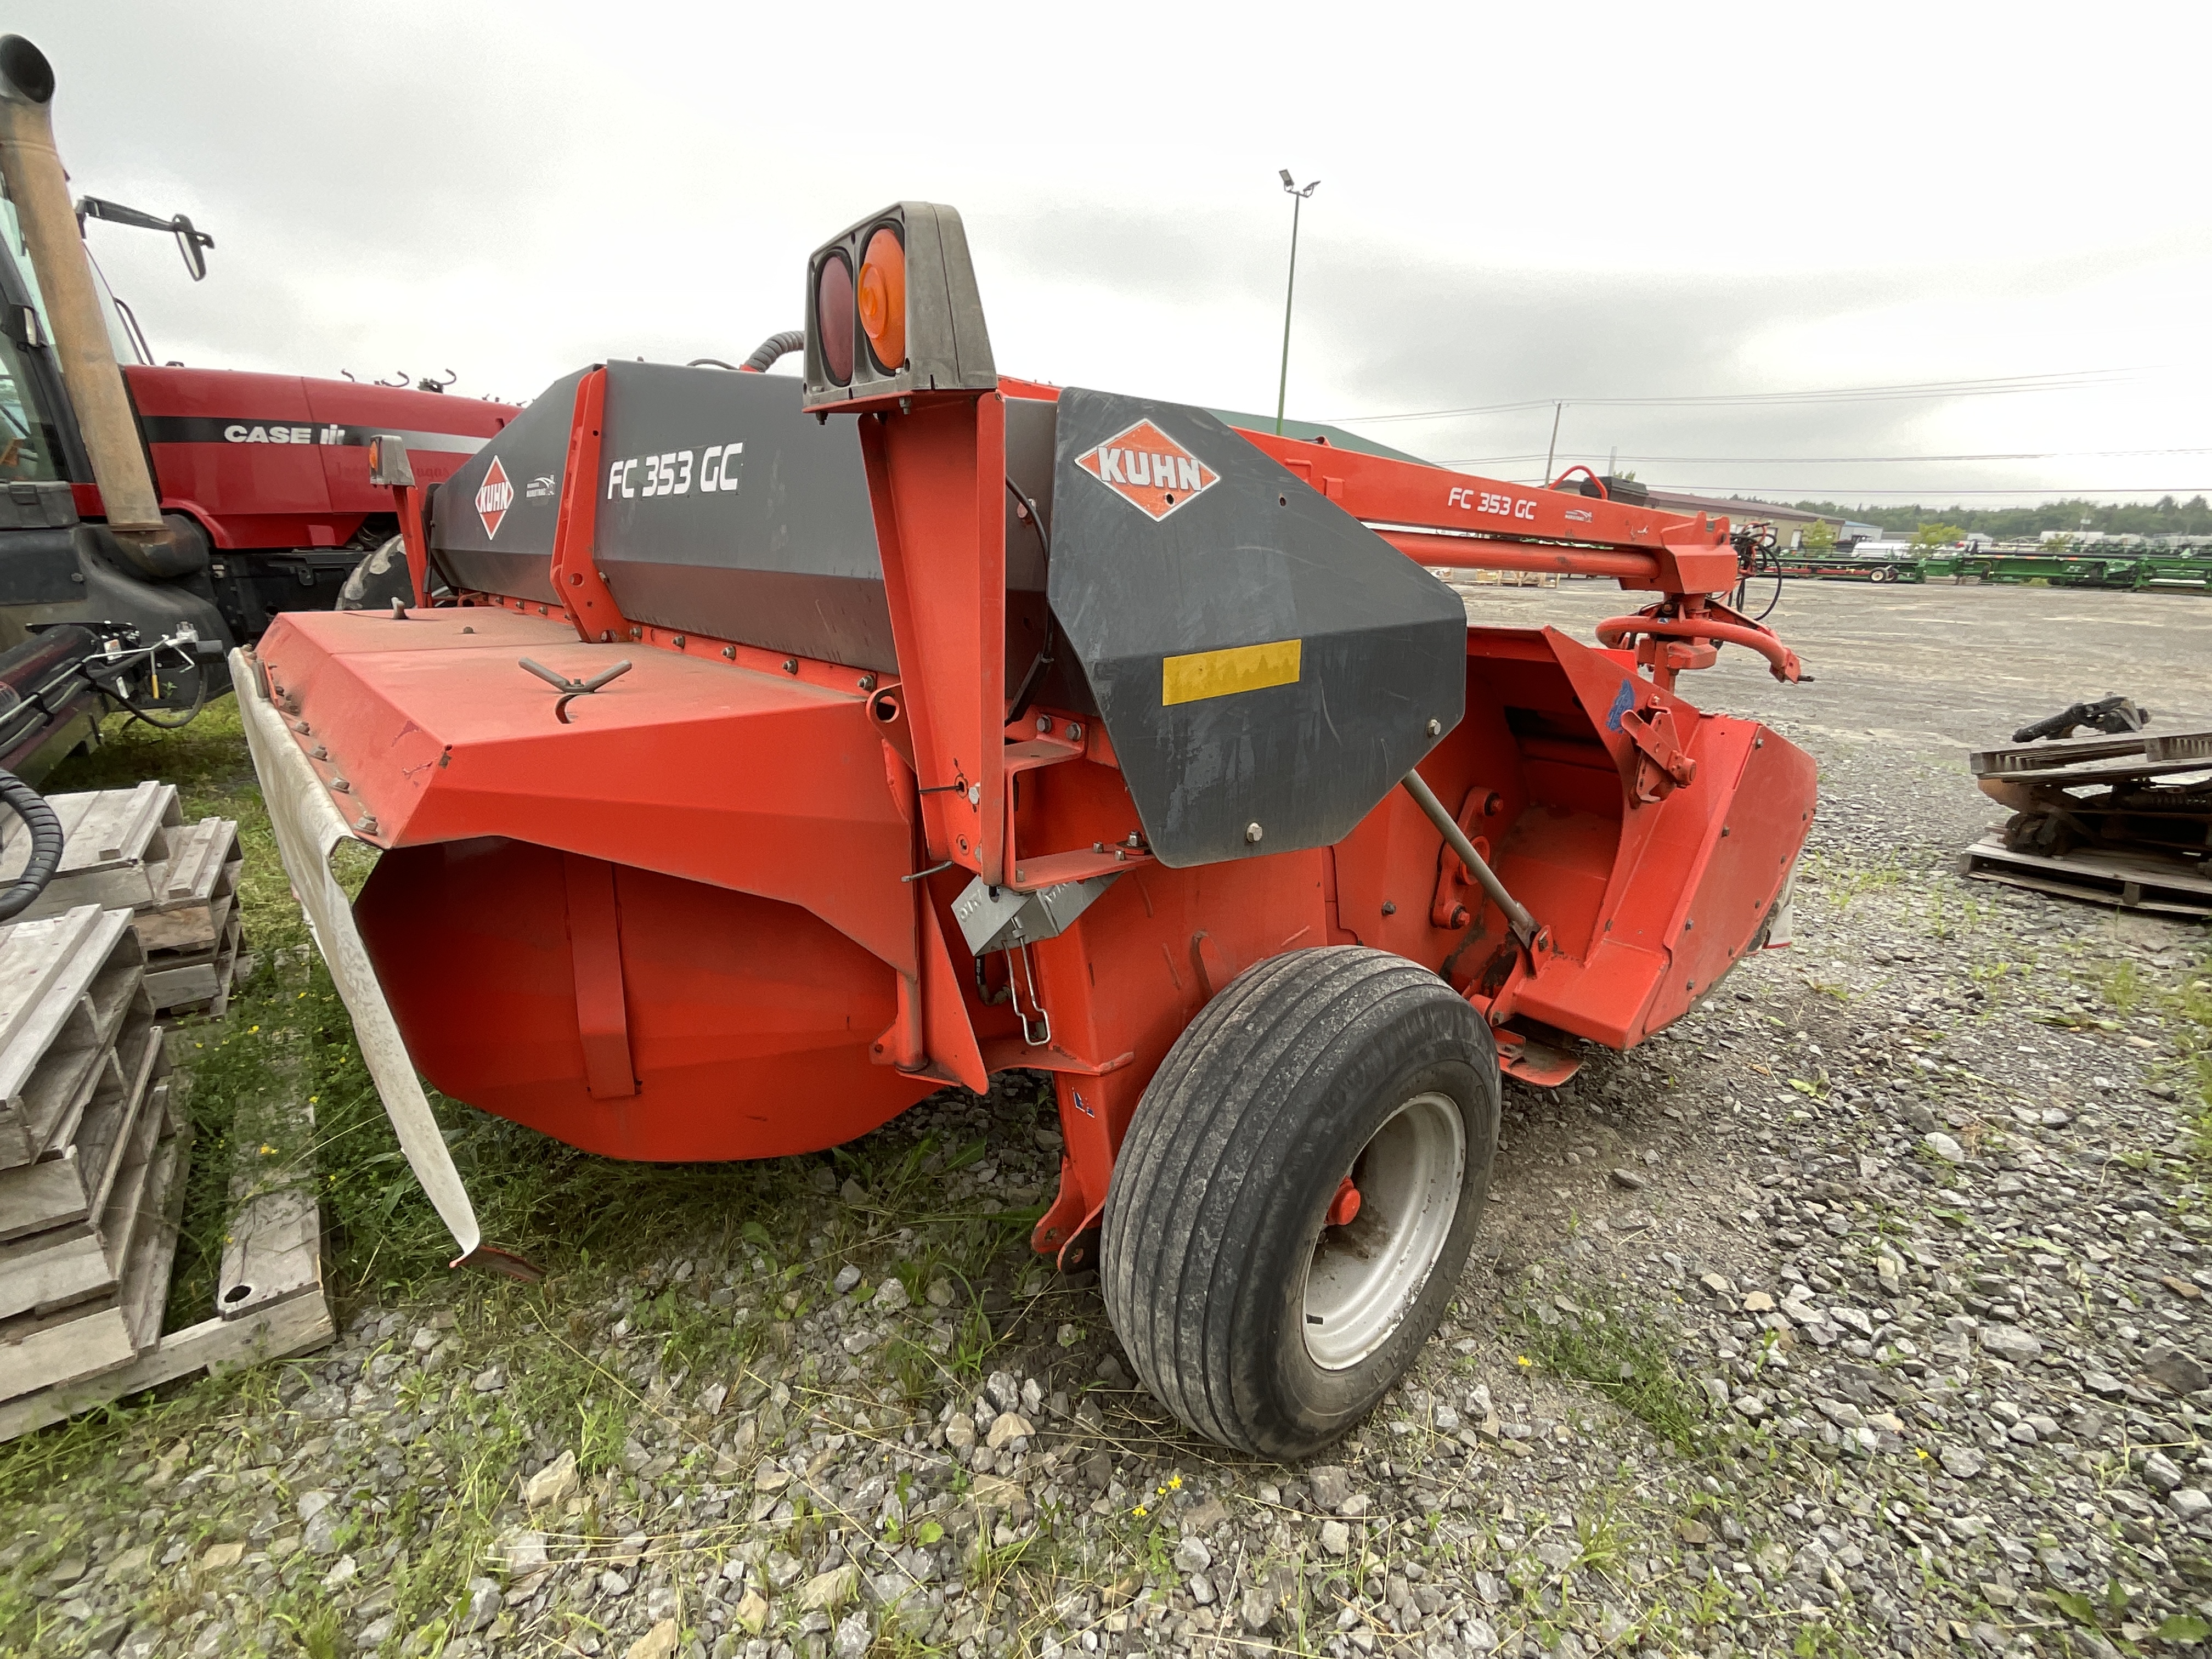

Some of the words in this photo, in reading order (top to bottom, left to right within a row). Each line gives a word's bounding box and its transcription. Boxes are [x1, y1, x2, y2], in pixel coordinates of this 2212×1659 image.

[224, 425, 312, 444] CASE
[607, 459, 637, 499] FC
[642, 450, 693, 497] 353
[700, 442, 743, 492] GC
[1097, 445, 1203, 492] KUHN
[479, 480, 509, 514] KUHN
[1448, 487, 1474, 509] FC
[1477, 492, 1511, 516] 353
[1515, 499, 1537, 520] GC
